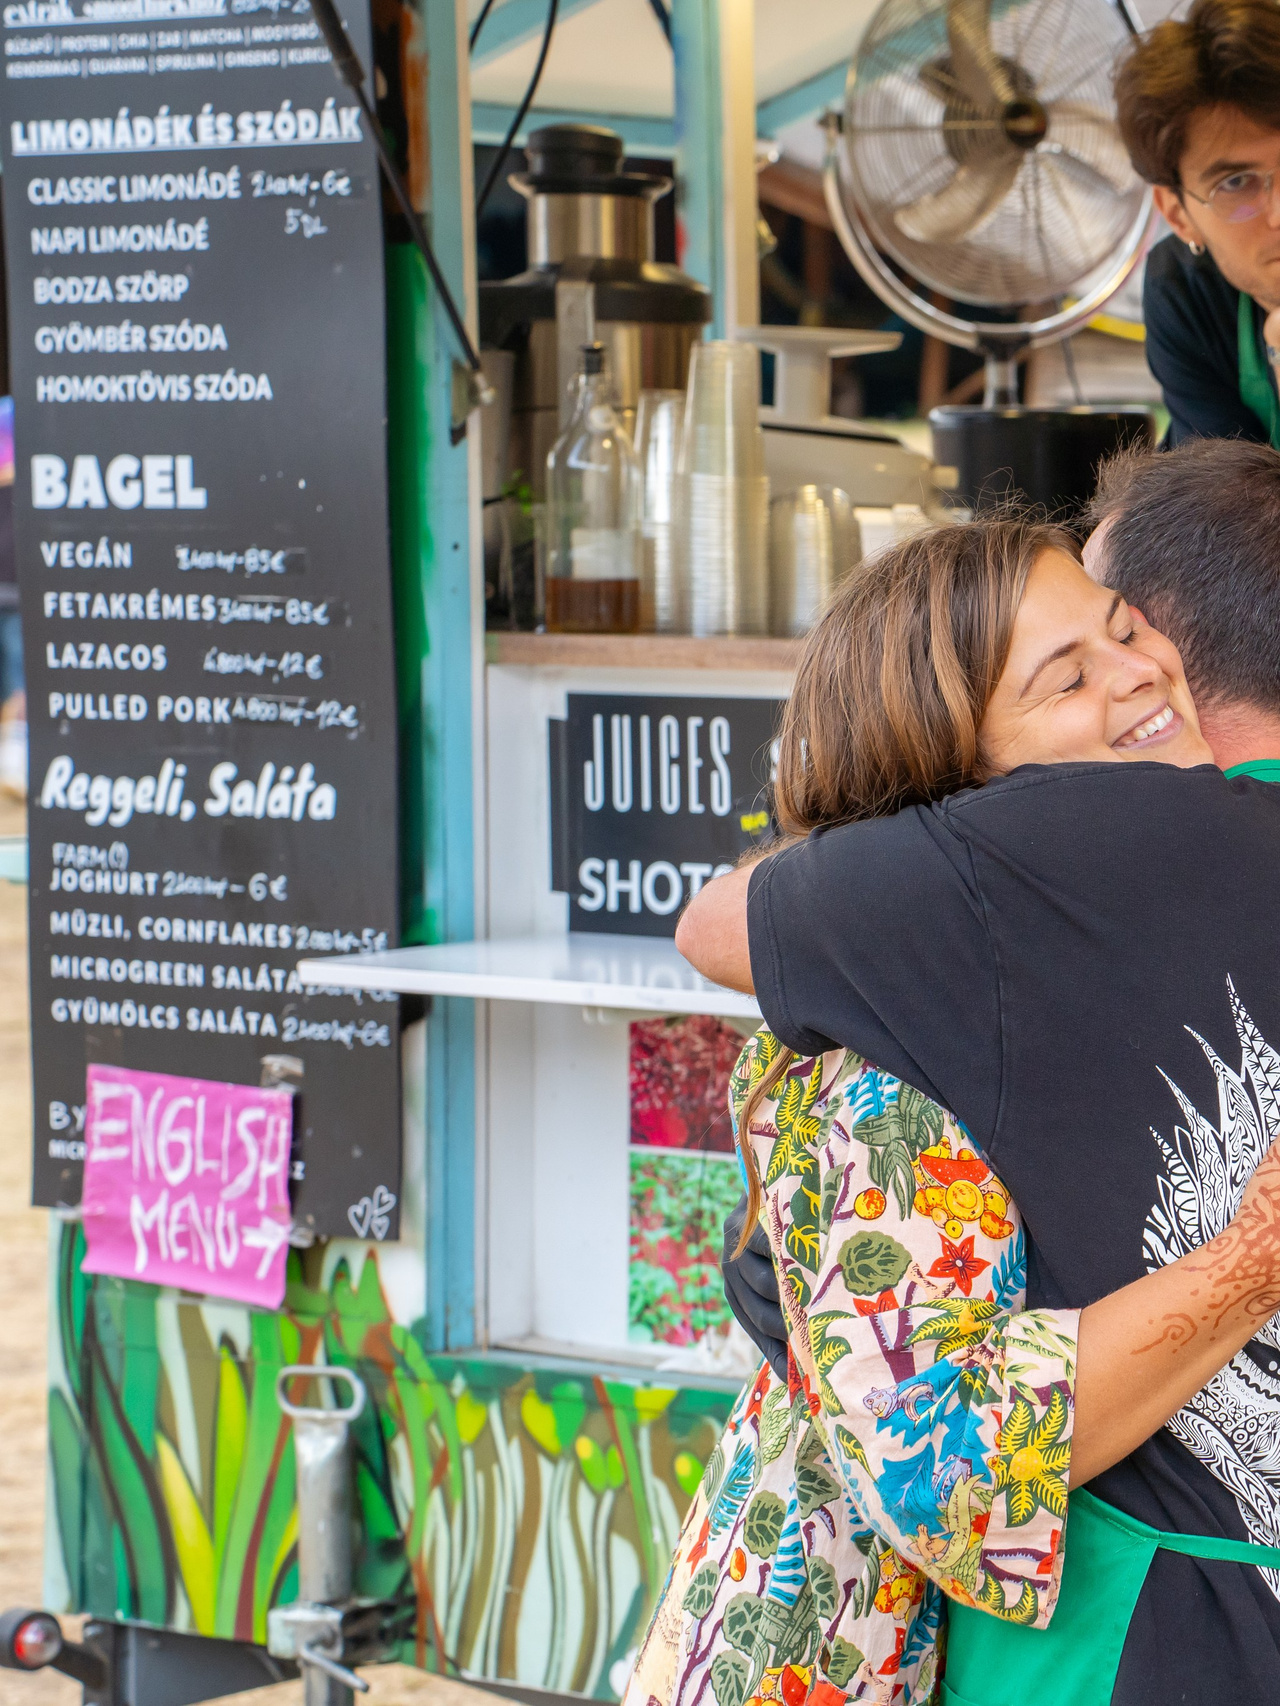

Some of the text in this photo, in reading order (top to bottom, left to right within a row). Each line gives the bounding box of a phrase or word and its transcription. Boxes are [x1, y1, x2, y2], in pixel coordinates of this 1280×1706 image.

[11, 97, 362, 151] LIMONÁDÉK ÉS SZÓDÁK
[28, 166, 241, 205] CLASSIC LIMONÁDÉ
[31, 217, 209, 253] NAPI LIMONÁDÉ
[34, 271, 188, 304] BODZA SZÖRP
[35, 319, 227, 353] GYÖMBÉR SZÓDA
[37, 368, 272, 402] HOMOKTÖVIS SZÓDA
[31, 455, 206, 509] BAGEL
[41, 537, 131, 567] VEGÁN
[42, 587, 216, 622] FETAKRÉMES
[47, 643, 166, 670] LAZACOS
[49, 692, 231, 724] PULLED PORK
[583, 713, 732, 817] JUICES
[41, 756, 335, 826] Reggeli, Saláta
[50, 868, 158, 897] JOGHURT
[577, 857, 735, 916] SHOT
[50, 909, 291, 948] MÜZLI, CORNFLAKES
[49, 955, 205, 989] MICROGREEN
[211, 963, 303, 995] SALÁTA
[51, 997, 279, 1038] GYÜMÖLCS SALÁTA
[90, 1080, 288, 1210] ENGLISH
[130, 1189, 238, 1274] MENU
